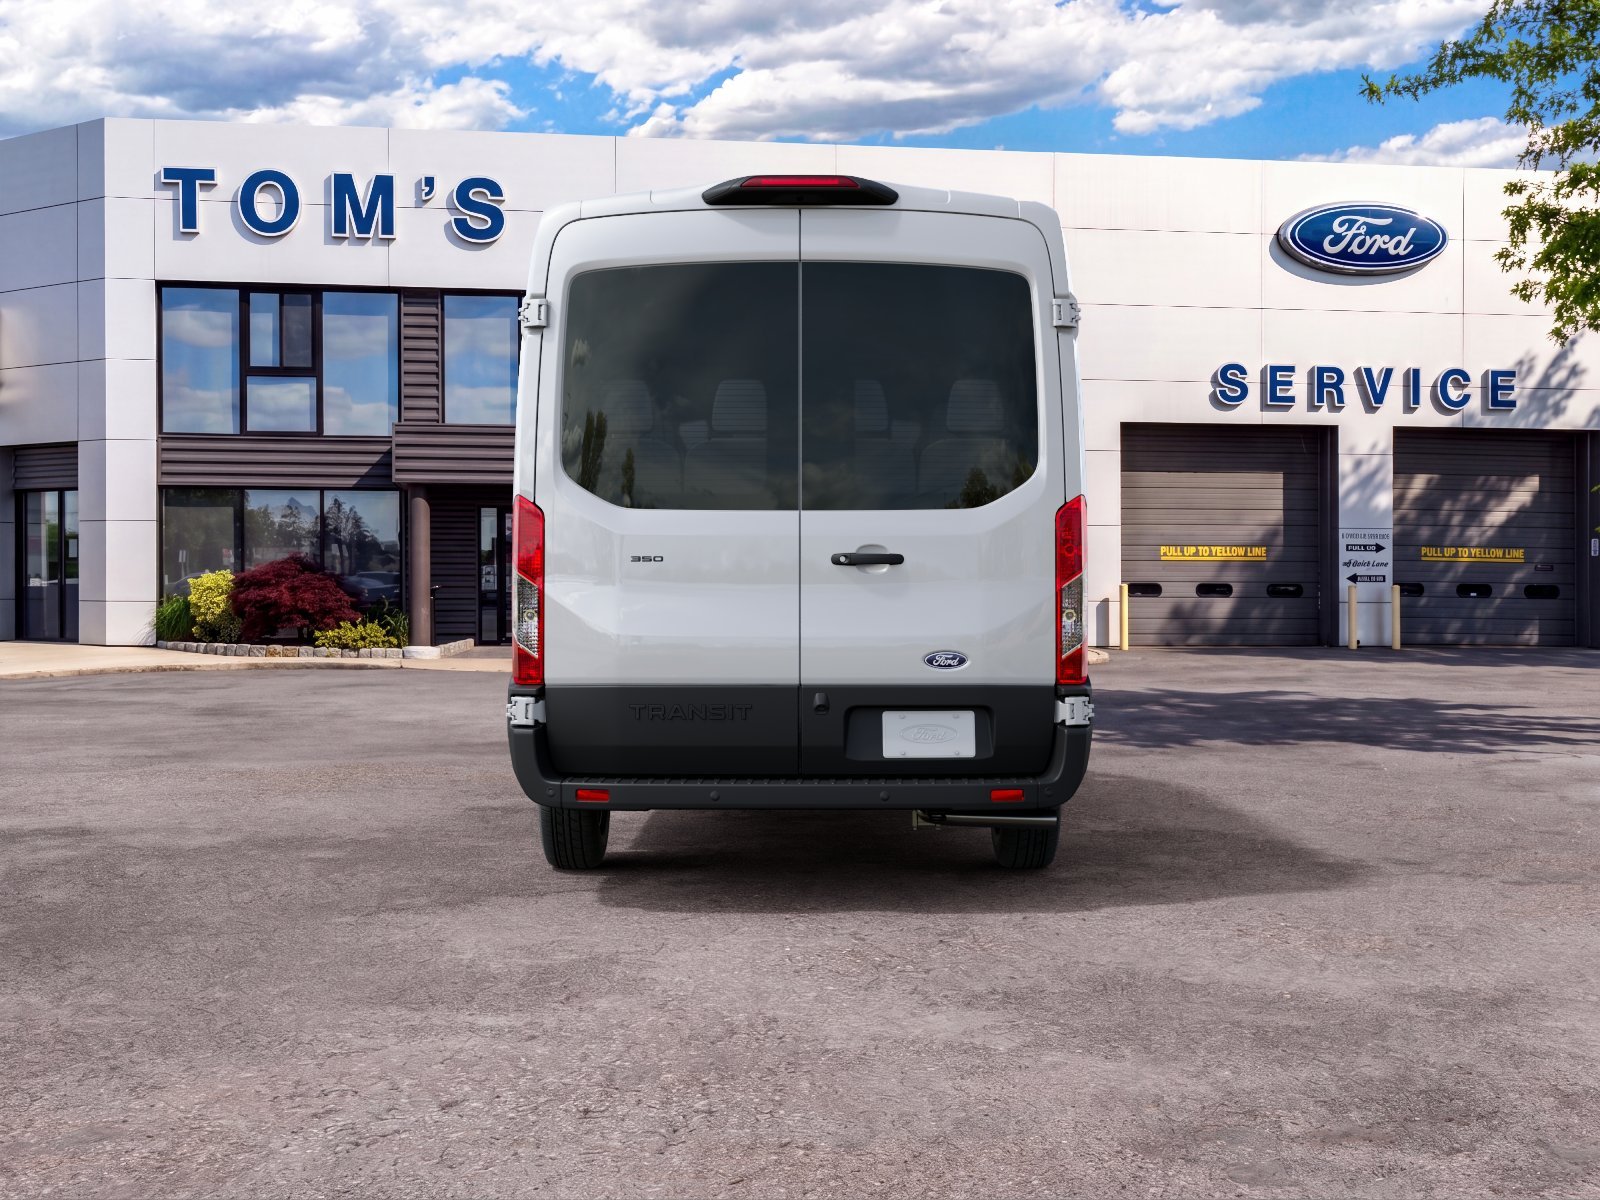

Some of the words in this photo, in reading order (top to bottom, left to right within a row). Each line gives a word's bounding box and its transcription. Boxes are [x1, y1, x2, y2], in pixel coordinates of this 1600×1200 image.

[1323, 215, 1416, 256] Ford
[1215, 362, 1518, 410] SERVICE
[1160, 545, 1182, 556] PULL
[1183, 546, 1197, 556] UP
[1198, 546, 1210, 557] TO
[1211, 547, 1246, 557] YELLOW
[1247, 547, 1267, 557] LINE
[1421, 547, 1443, 557] PULL
[1444, 547, 1456, 557] UP
[1457, 548, 1469, 558] TO
[1470, 548, 1504, 558] YELLOW
[1505, 549, 1525, 559] LINE
[630, 555, 664, 563] 350
[932, 654, 960, 666] Ford
[629, 703, 753, 721] TRANSIT
